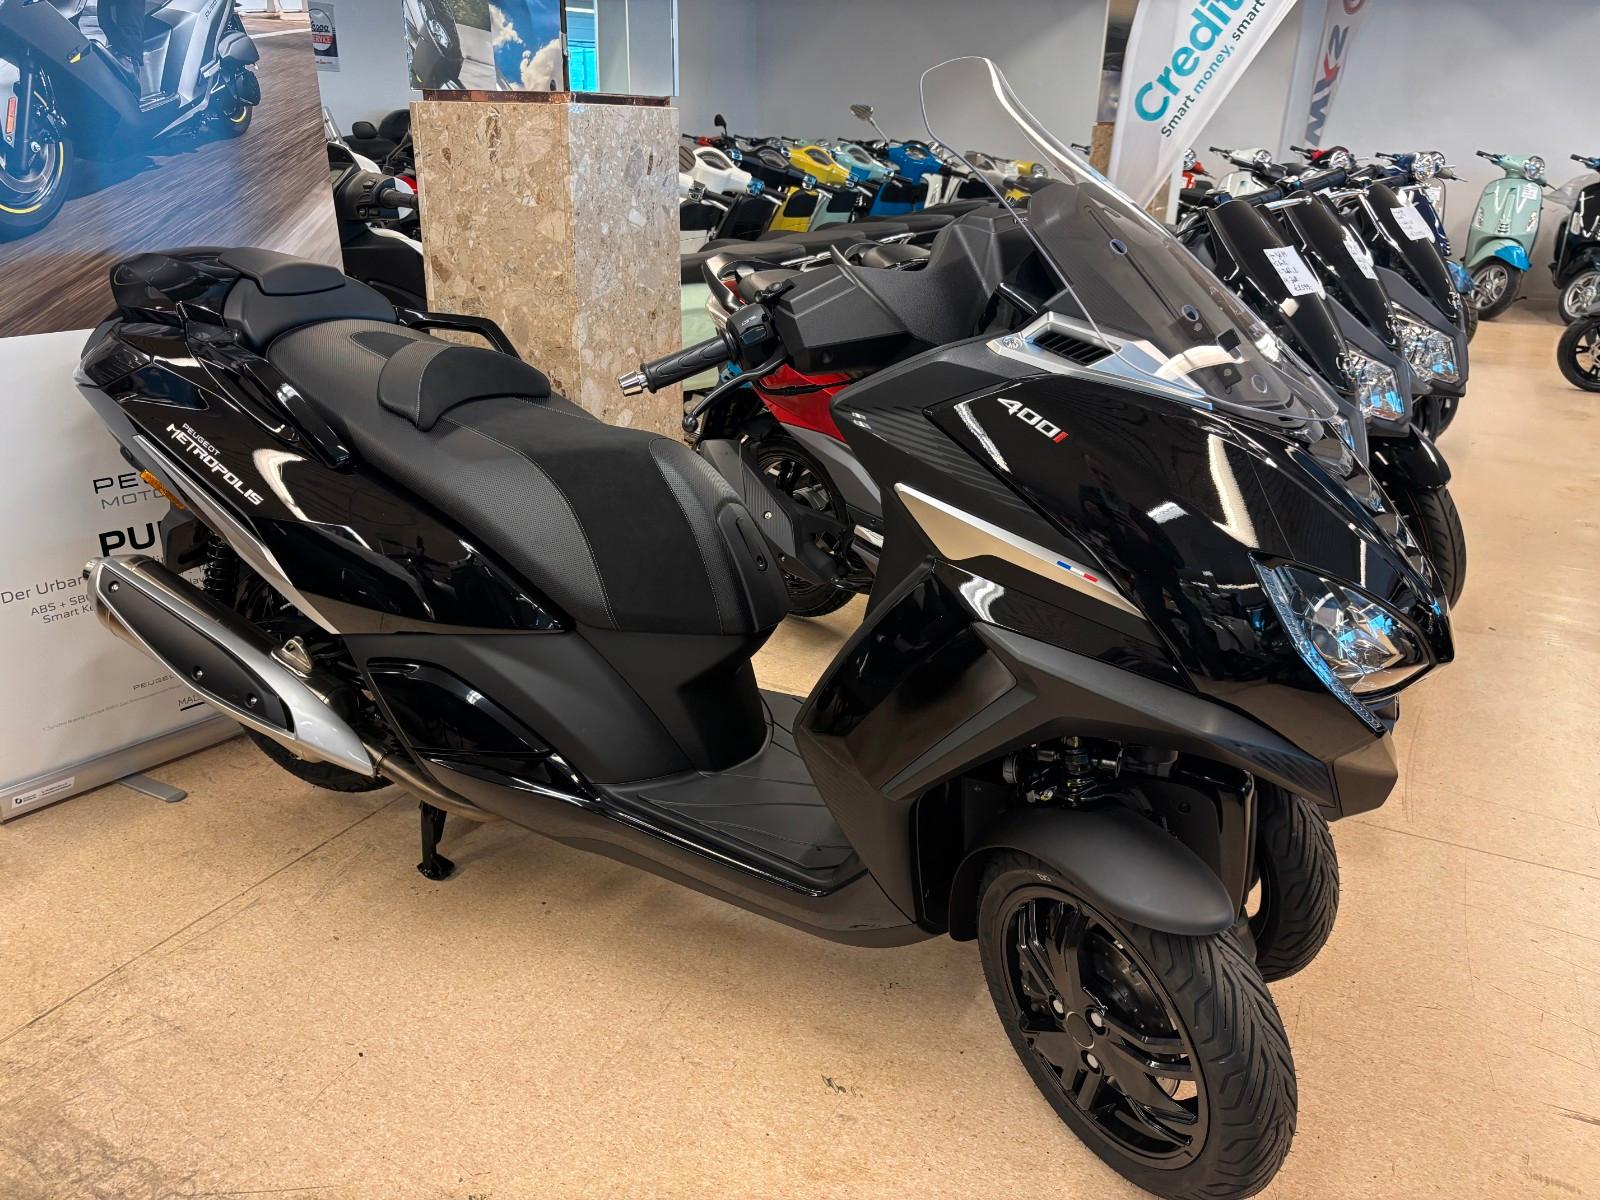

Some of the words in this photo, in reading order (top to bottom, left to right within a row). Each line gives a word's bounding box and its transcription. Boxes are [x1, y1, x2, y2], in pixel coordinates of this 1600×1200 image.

[1161, 95, 1196, 138] Smart
[1194, 44, 1235, 94] money,
[1232, 0, 1266, 41] smart
[182, 423, 220, 456] PEUGEOT
[166, 424, 264, 506] METROPOLIS
[93, 472, 148, 494] PE
[98, 521, 162, 558] PU
[1, 588, 31, 604] Der
[31, 602, 57, 616] ABS
[43, 608, 80, 624] Smart
